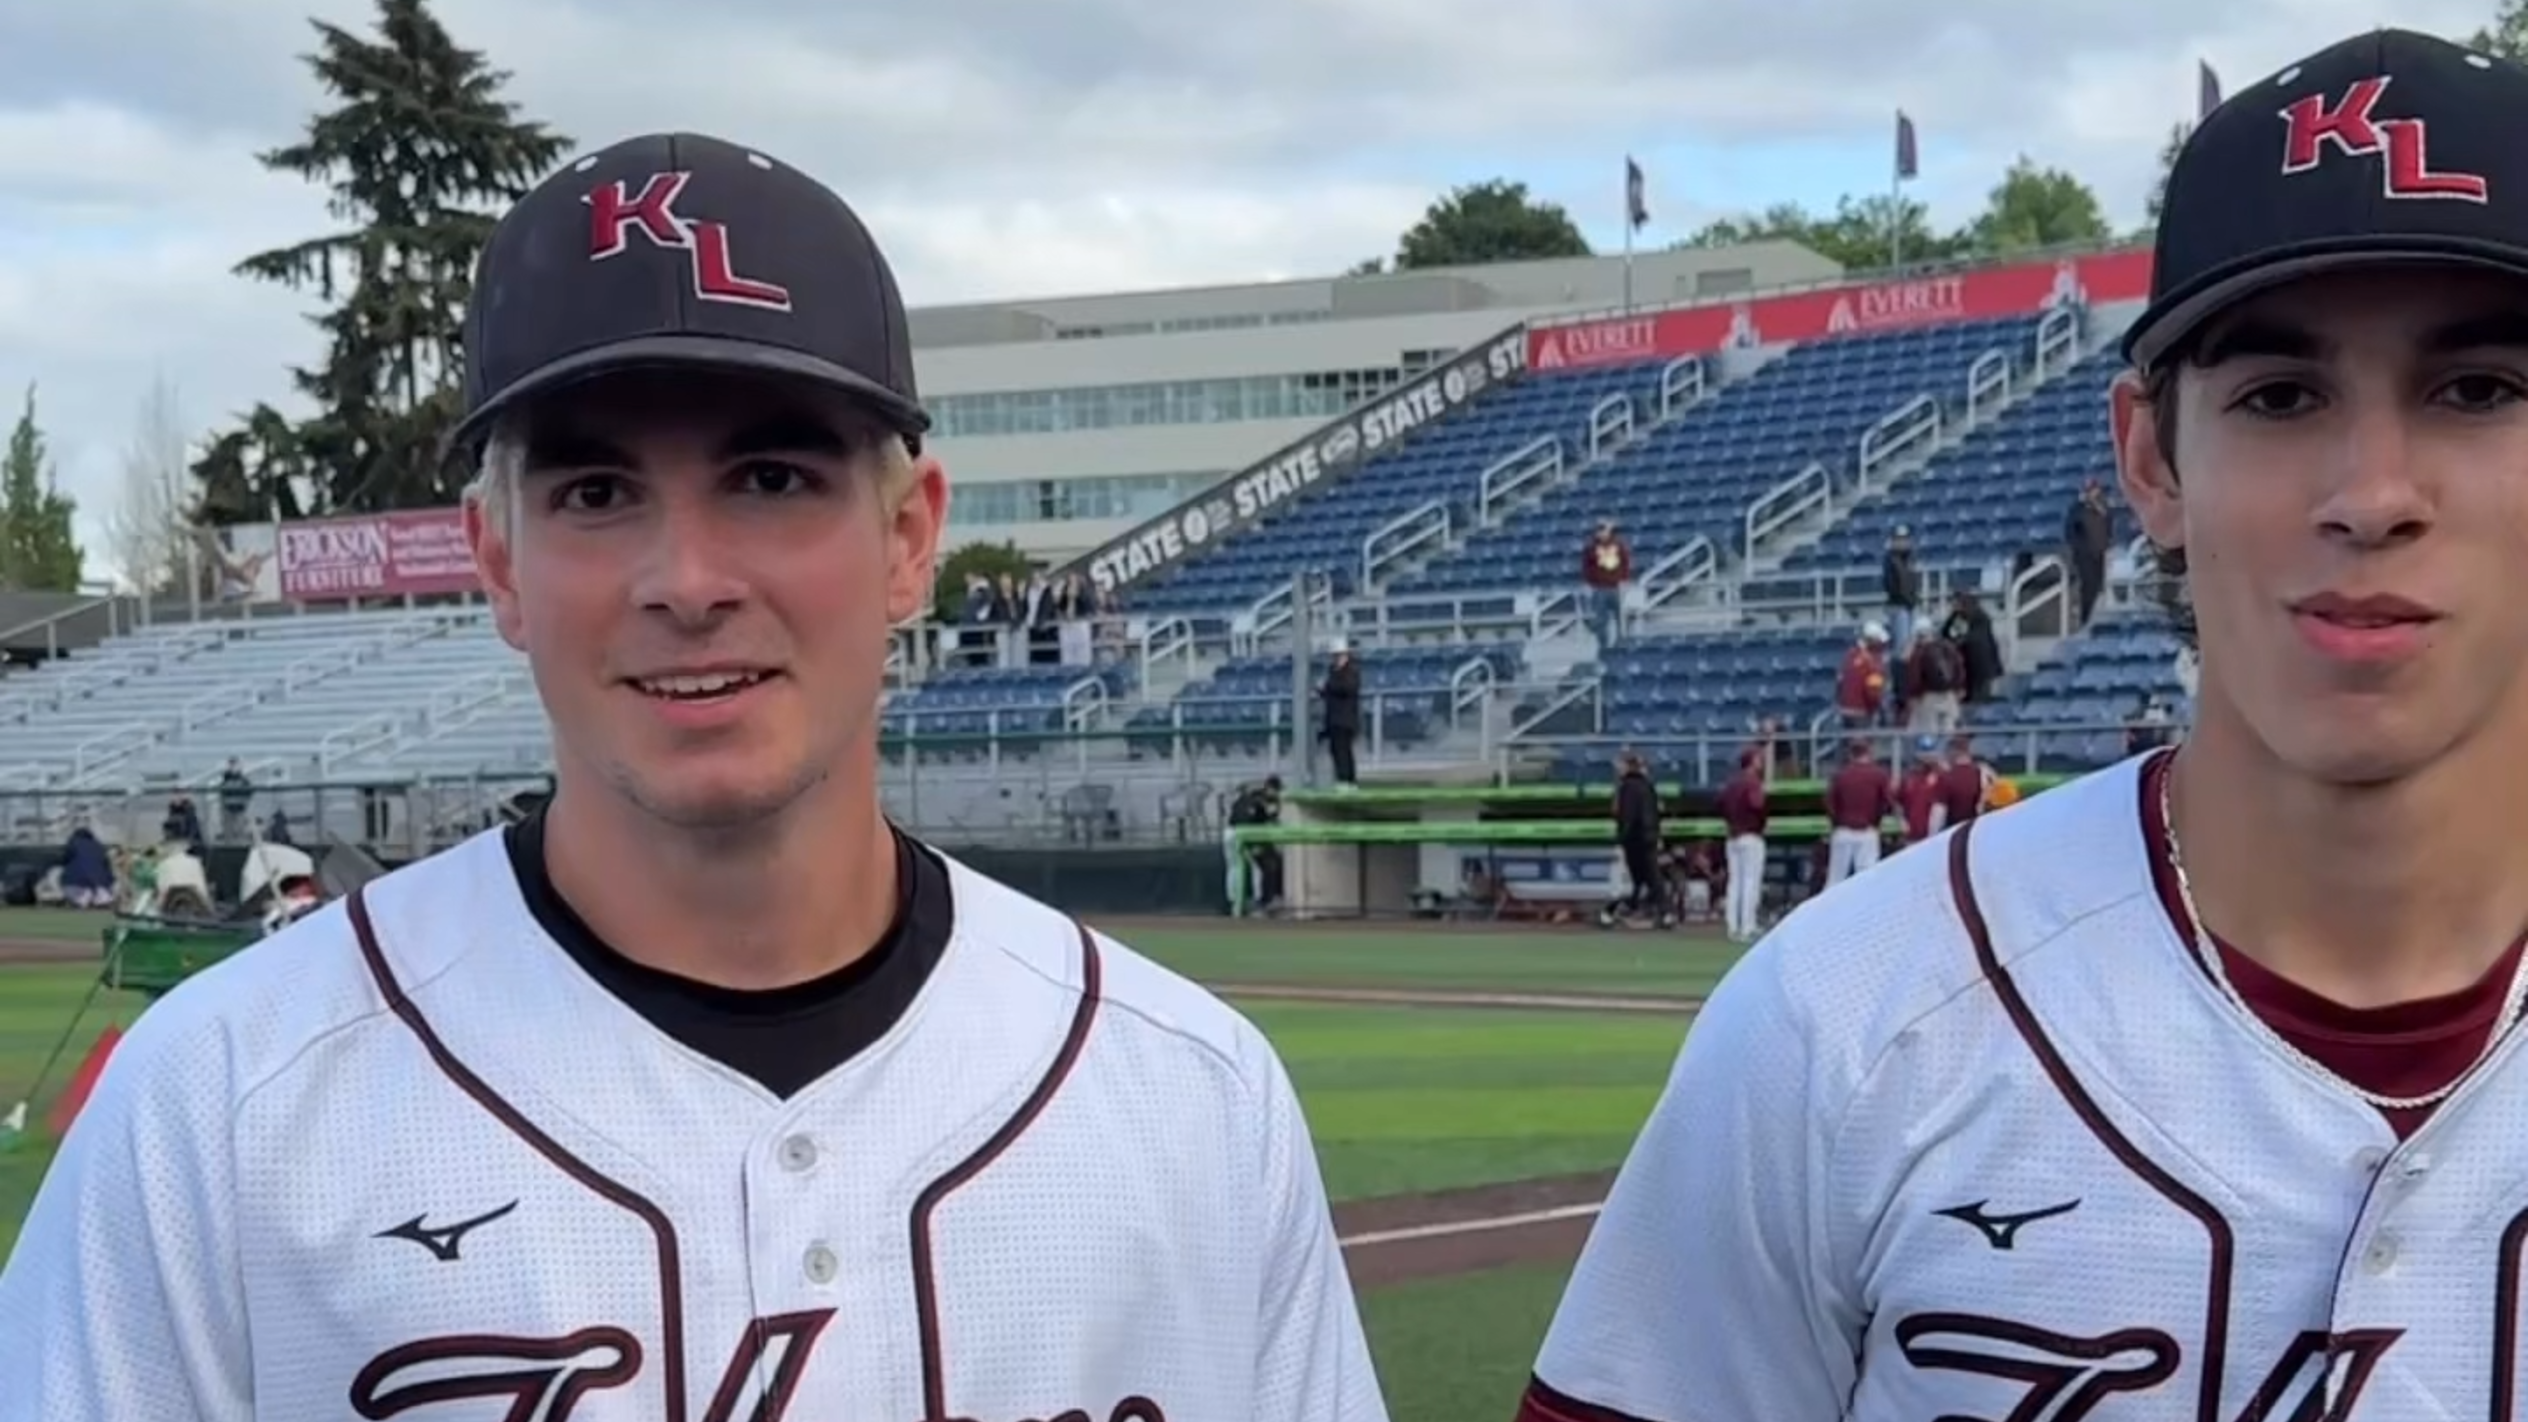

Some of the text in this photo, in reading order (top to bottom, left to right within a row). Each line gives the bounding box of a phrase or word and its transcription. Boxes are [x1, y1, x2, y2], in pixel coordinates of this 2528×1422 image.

[2277, 75, 2488, 204] KL
[581, 171, 792, 312] KL
[1860, 275, 1963, 319] EVERETT
[1566, 318, 1656, 356] EVERETT
[1088, 518, 1184, 592] STATE
[1233, 446, 1321, 517] STATE
[1361, 378, 1445, 448] STATE
[281, 523, 389, 571] ERICKSON
[285, 565, 384, 592] FURNITURE
